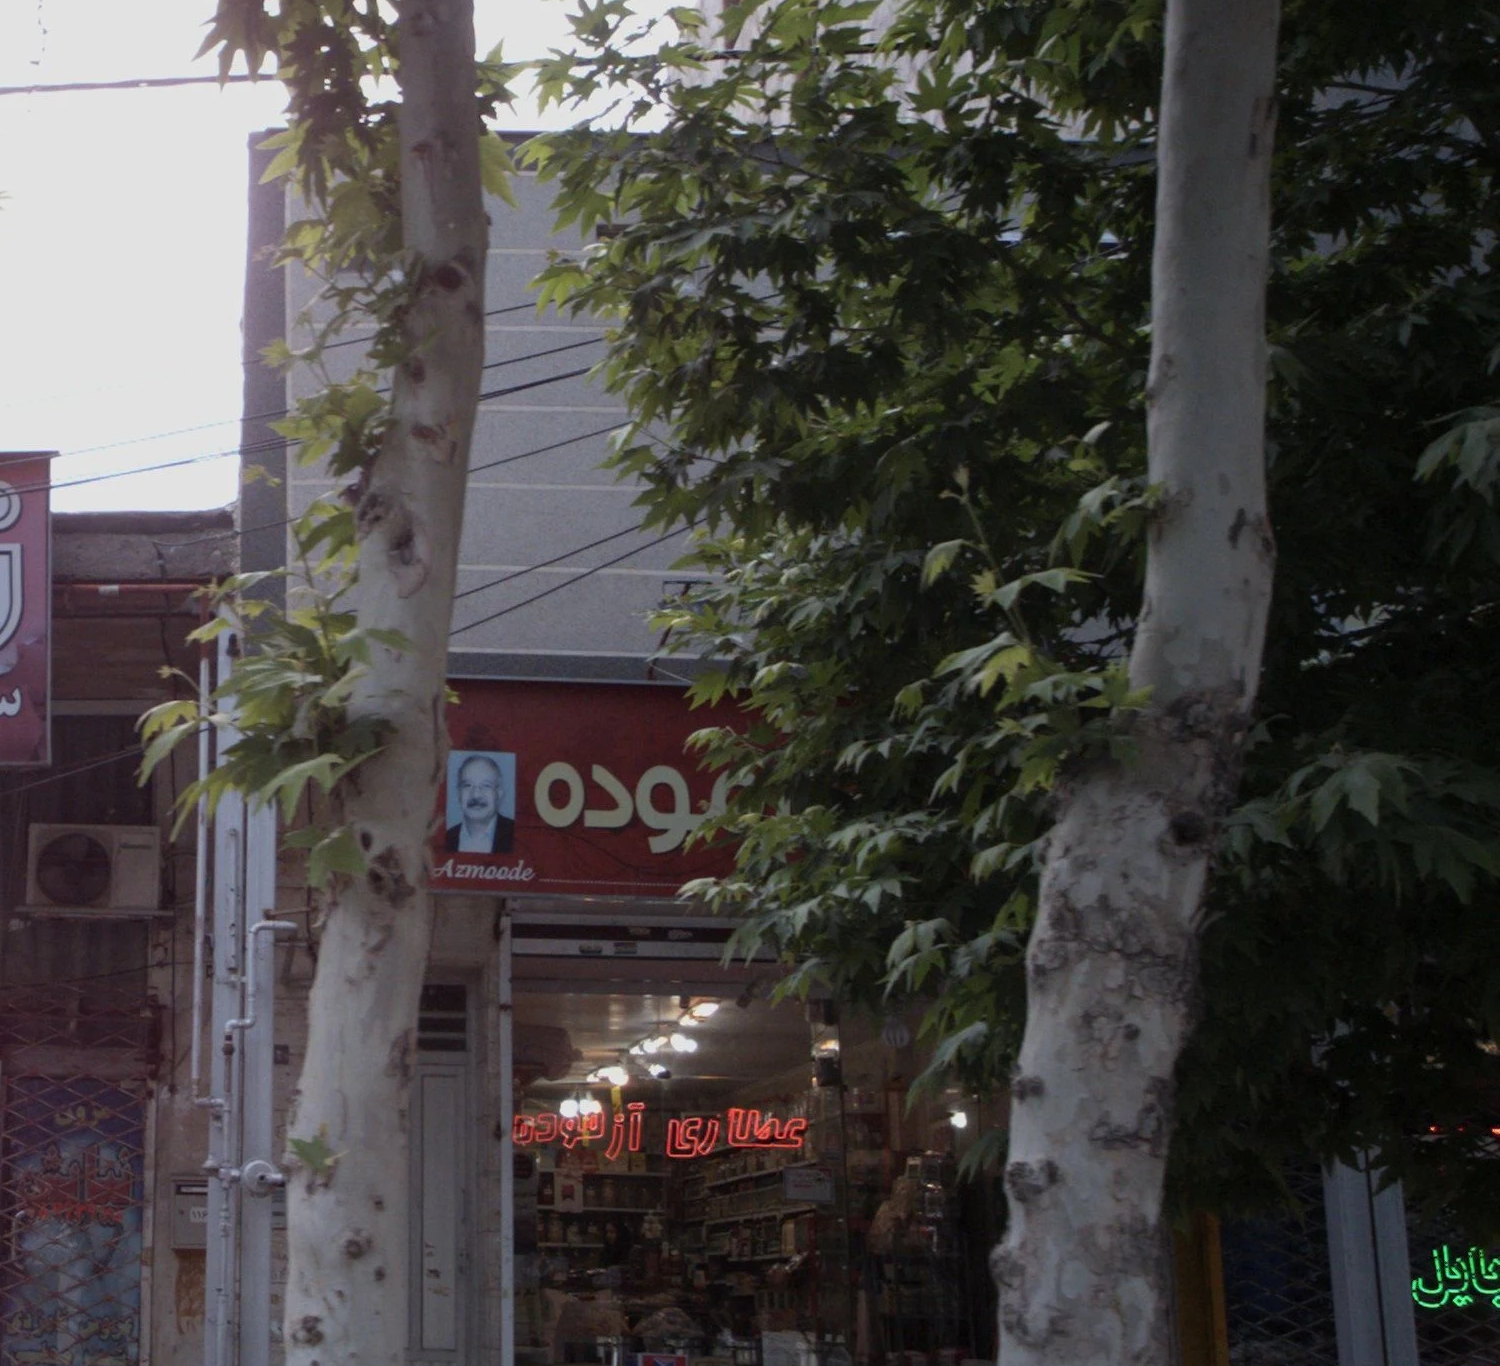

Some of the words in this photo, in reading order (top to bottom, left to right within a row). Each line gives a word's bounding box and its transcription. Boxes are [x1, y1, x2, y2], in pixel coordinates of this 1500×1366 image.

[534, 761, 760, 854] موده
[433, 858, 537, 882] Azmoode
[665, 1107, 809, 1159] عطاری
